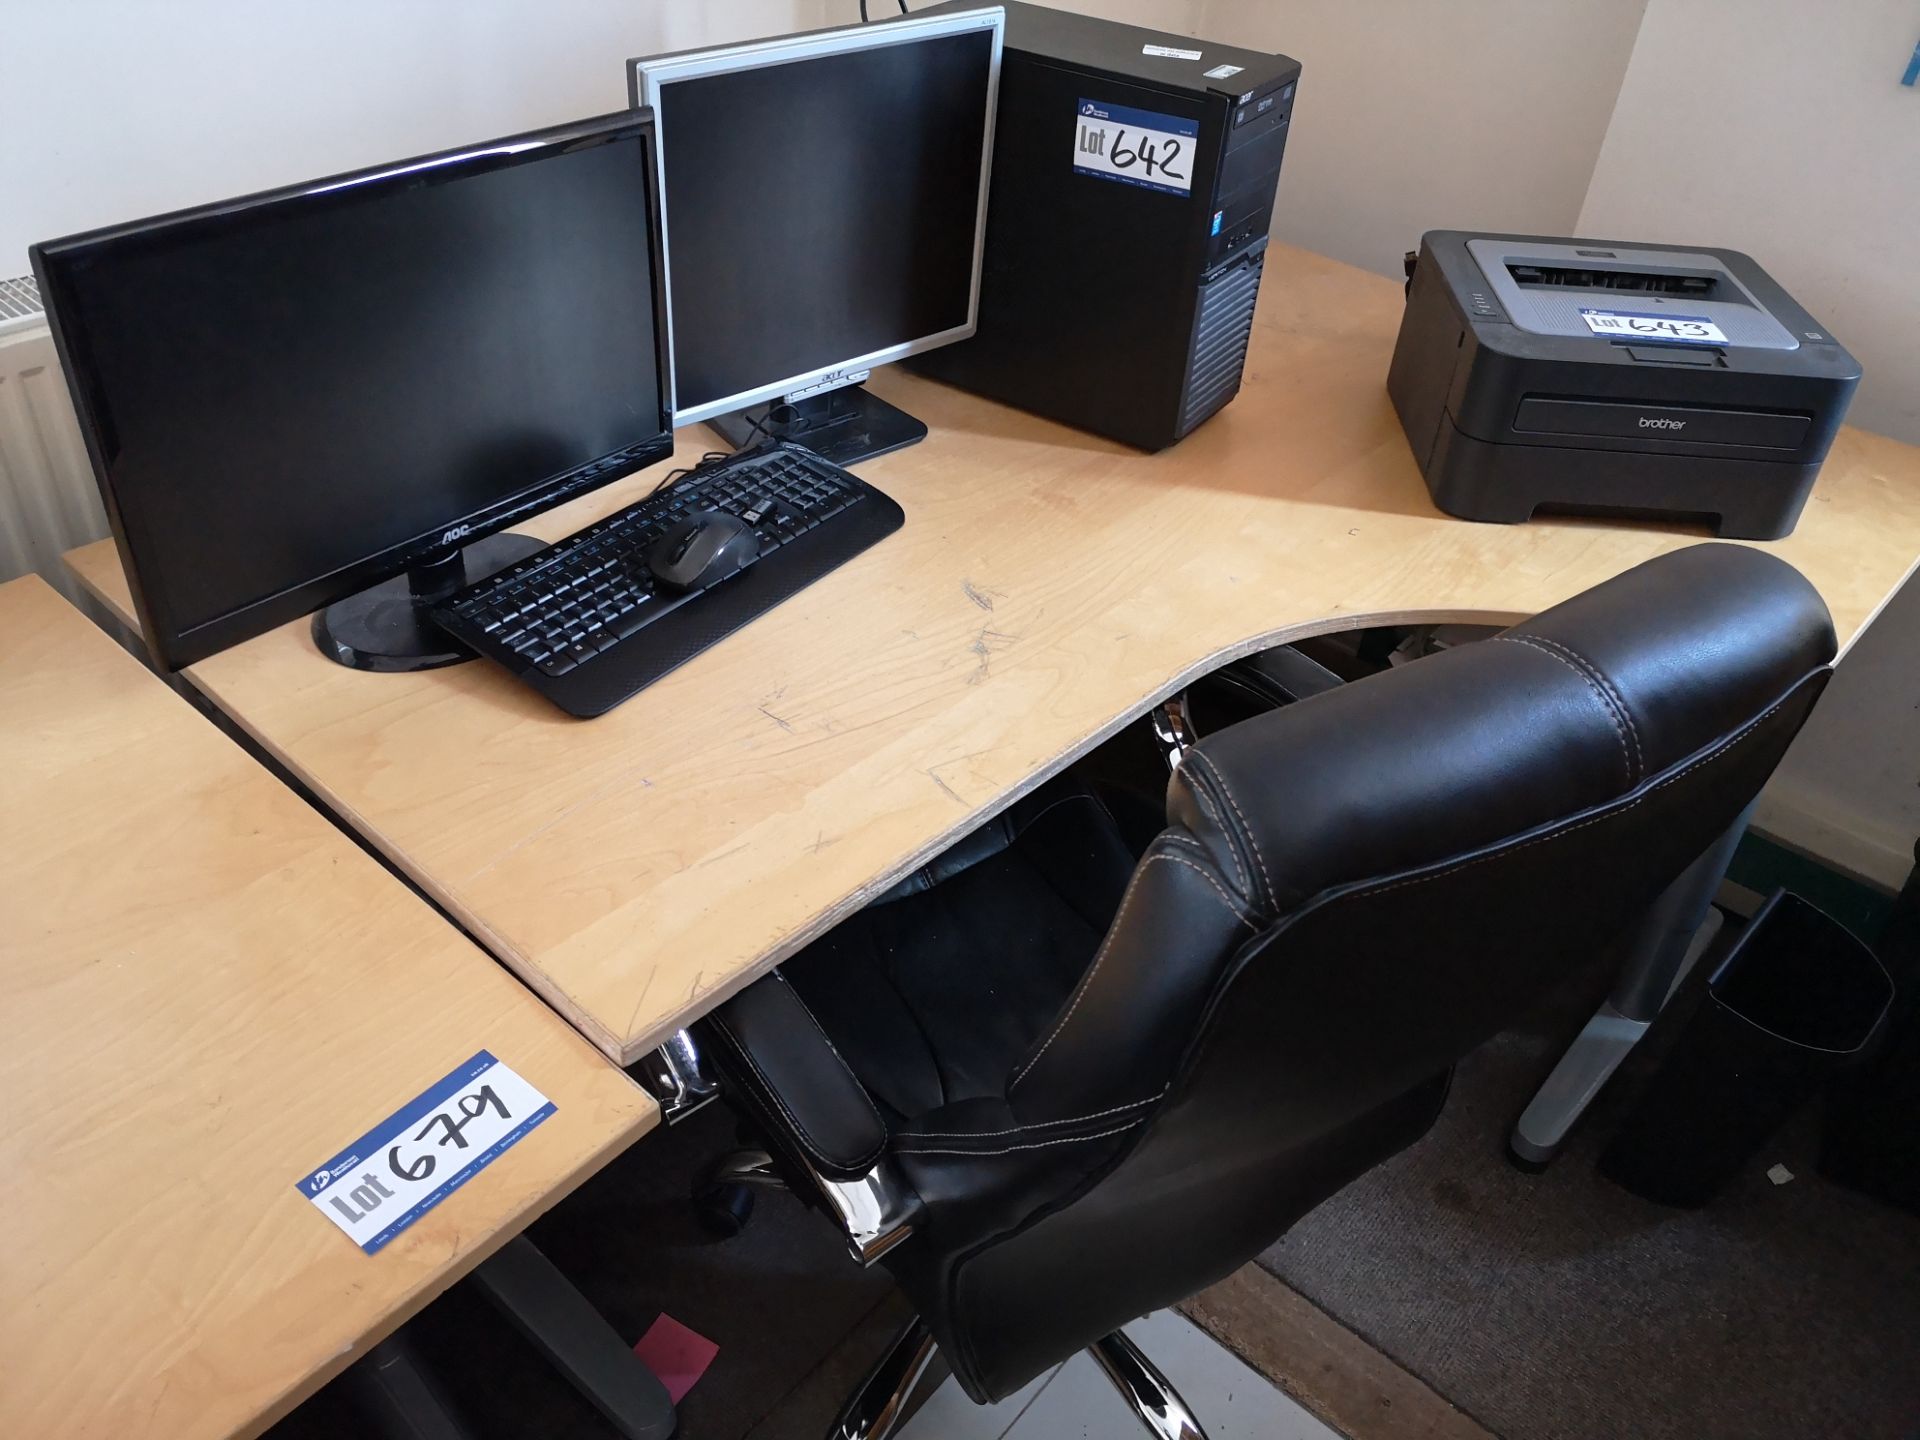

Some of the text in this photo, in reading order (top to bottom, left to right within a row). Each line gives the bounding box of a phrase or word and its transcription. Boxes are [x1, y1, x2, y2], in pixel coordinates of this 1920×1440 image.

[1080, 125, 1184, 180] Lot 642
[1590, 317, 1710, 337] Lot 643
[1638, 416, 1687, 430] brother
[441, 524, 469, 545] AOC
[329, 1085, 512, 1225] Lot 679
